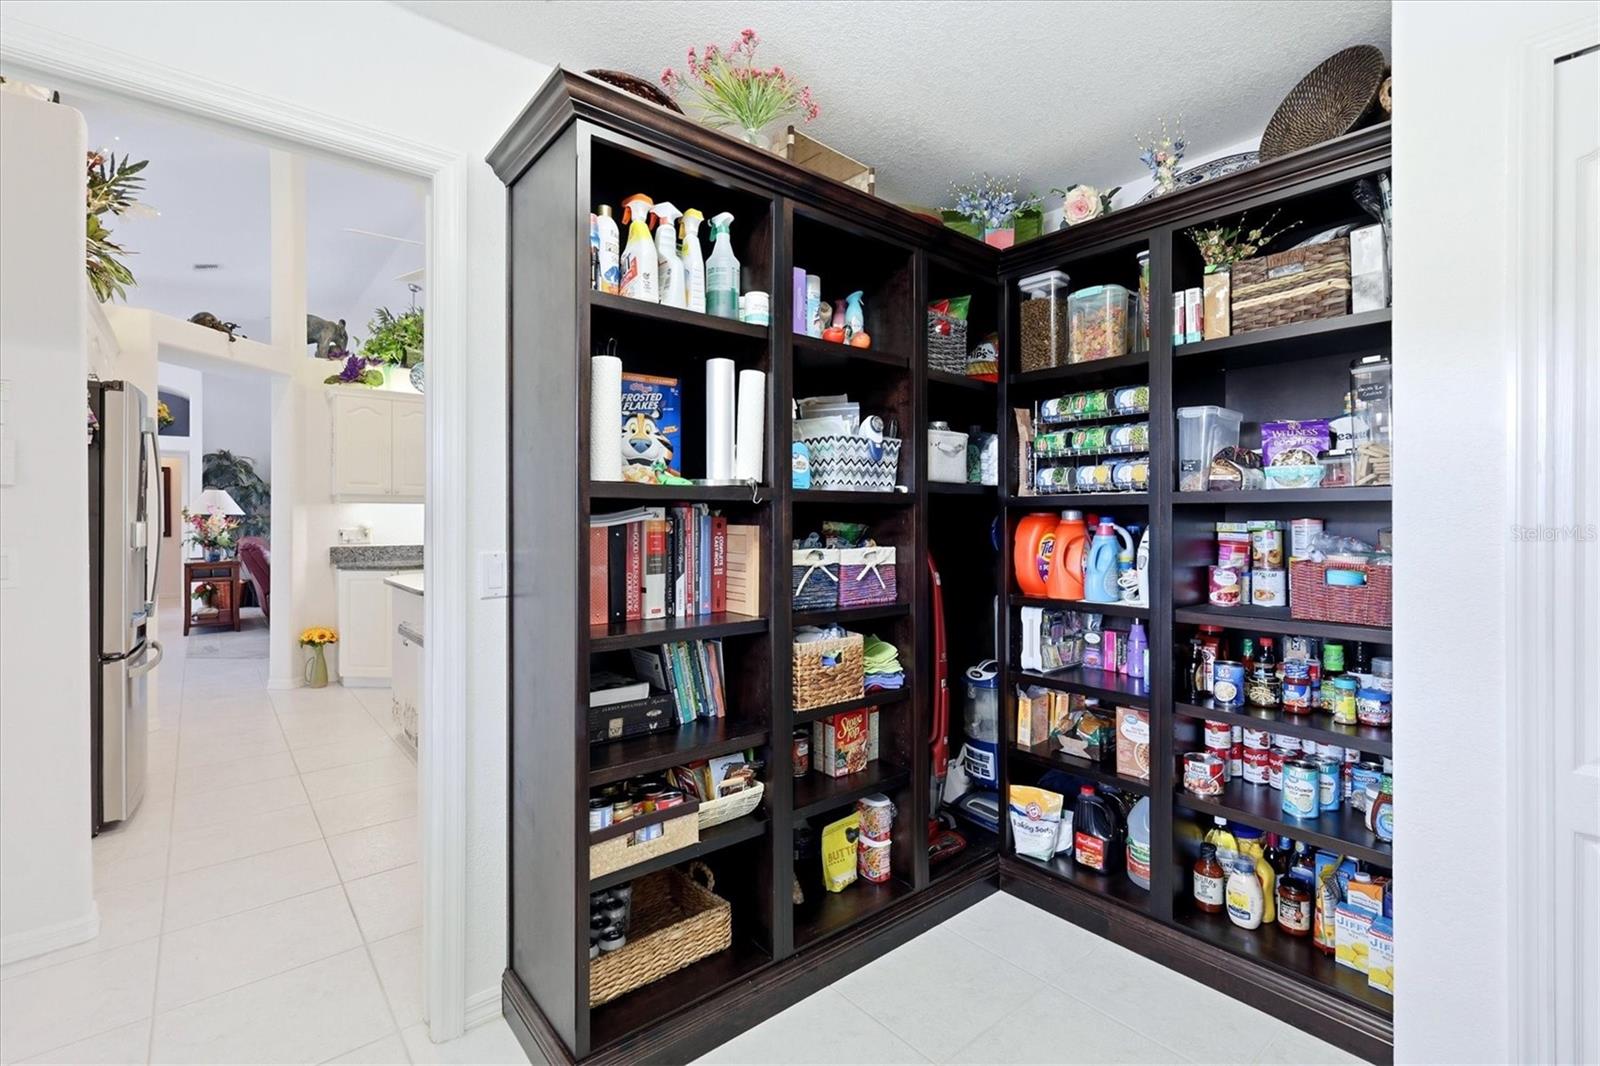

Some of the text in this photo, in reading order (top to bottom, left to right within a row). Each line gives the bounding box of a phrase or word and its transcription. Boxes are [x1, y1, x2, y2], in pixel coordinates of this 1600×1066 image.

[622, 393, 663, 402] FROSTED
[622, 401, 659, 411] FLAKES
[1271, 428, 1319, 438] WELLNESS
[1041, 540, 1055, 556] Tid
[1370, 938, 1393, 954] JIF
